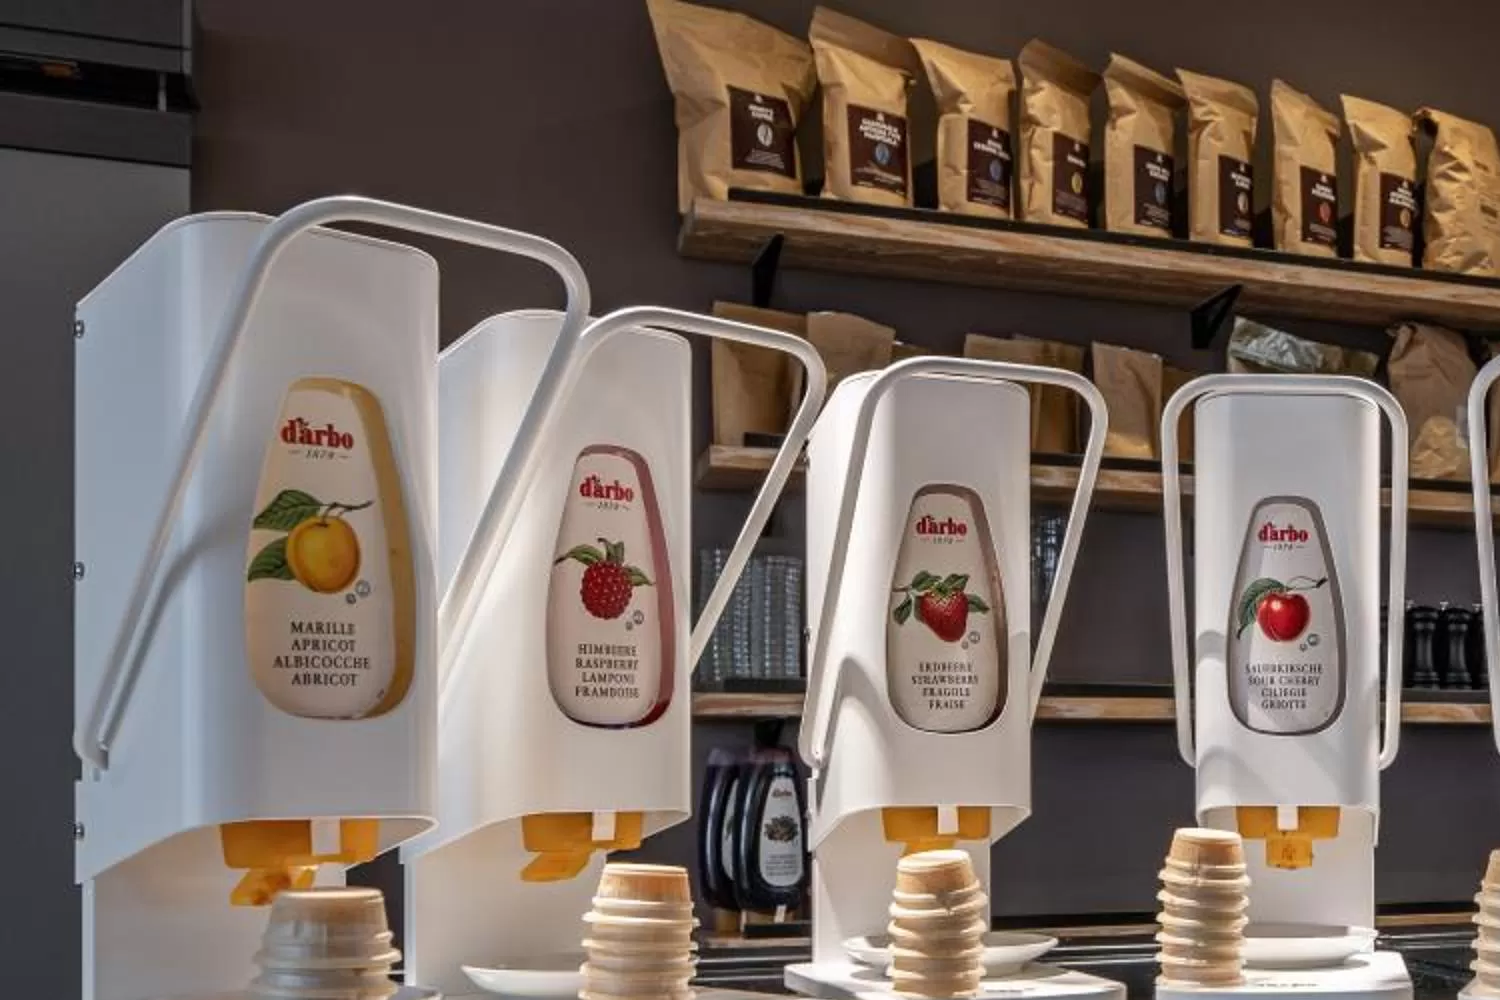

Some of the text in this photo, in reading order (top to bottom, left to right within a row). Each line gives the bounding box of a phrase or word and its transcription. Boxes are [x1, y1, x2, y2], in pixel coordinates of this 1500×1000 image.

[291, 621, 356, 635] MARILLE
[291, 639, 356, 652] APRICOT
[272, 655, 370, 670] ALBICOCCHE
[291, 673, 360, 687] ABRICOT
